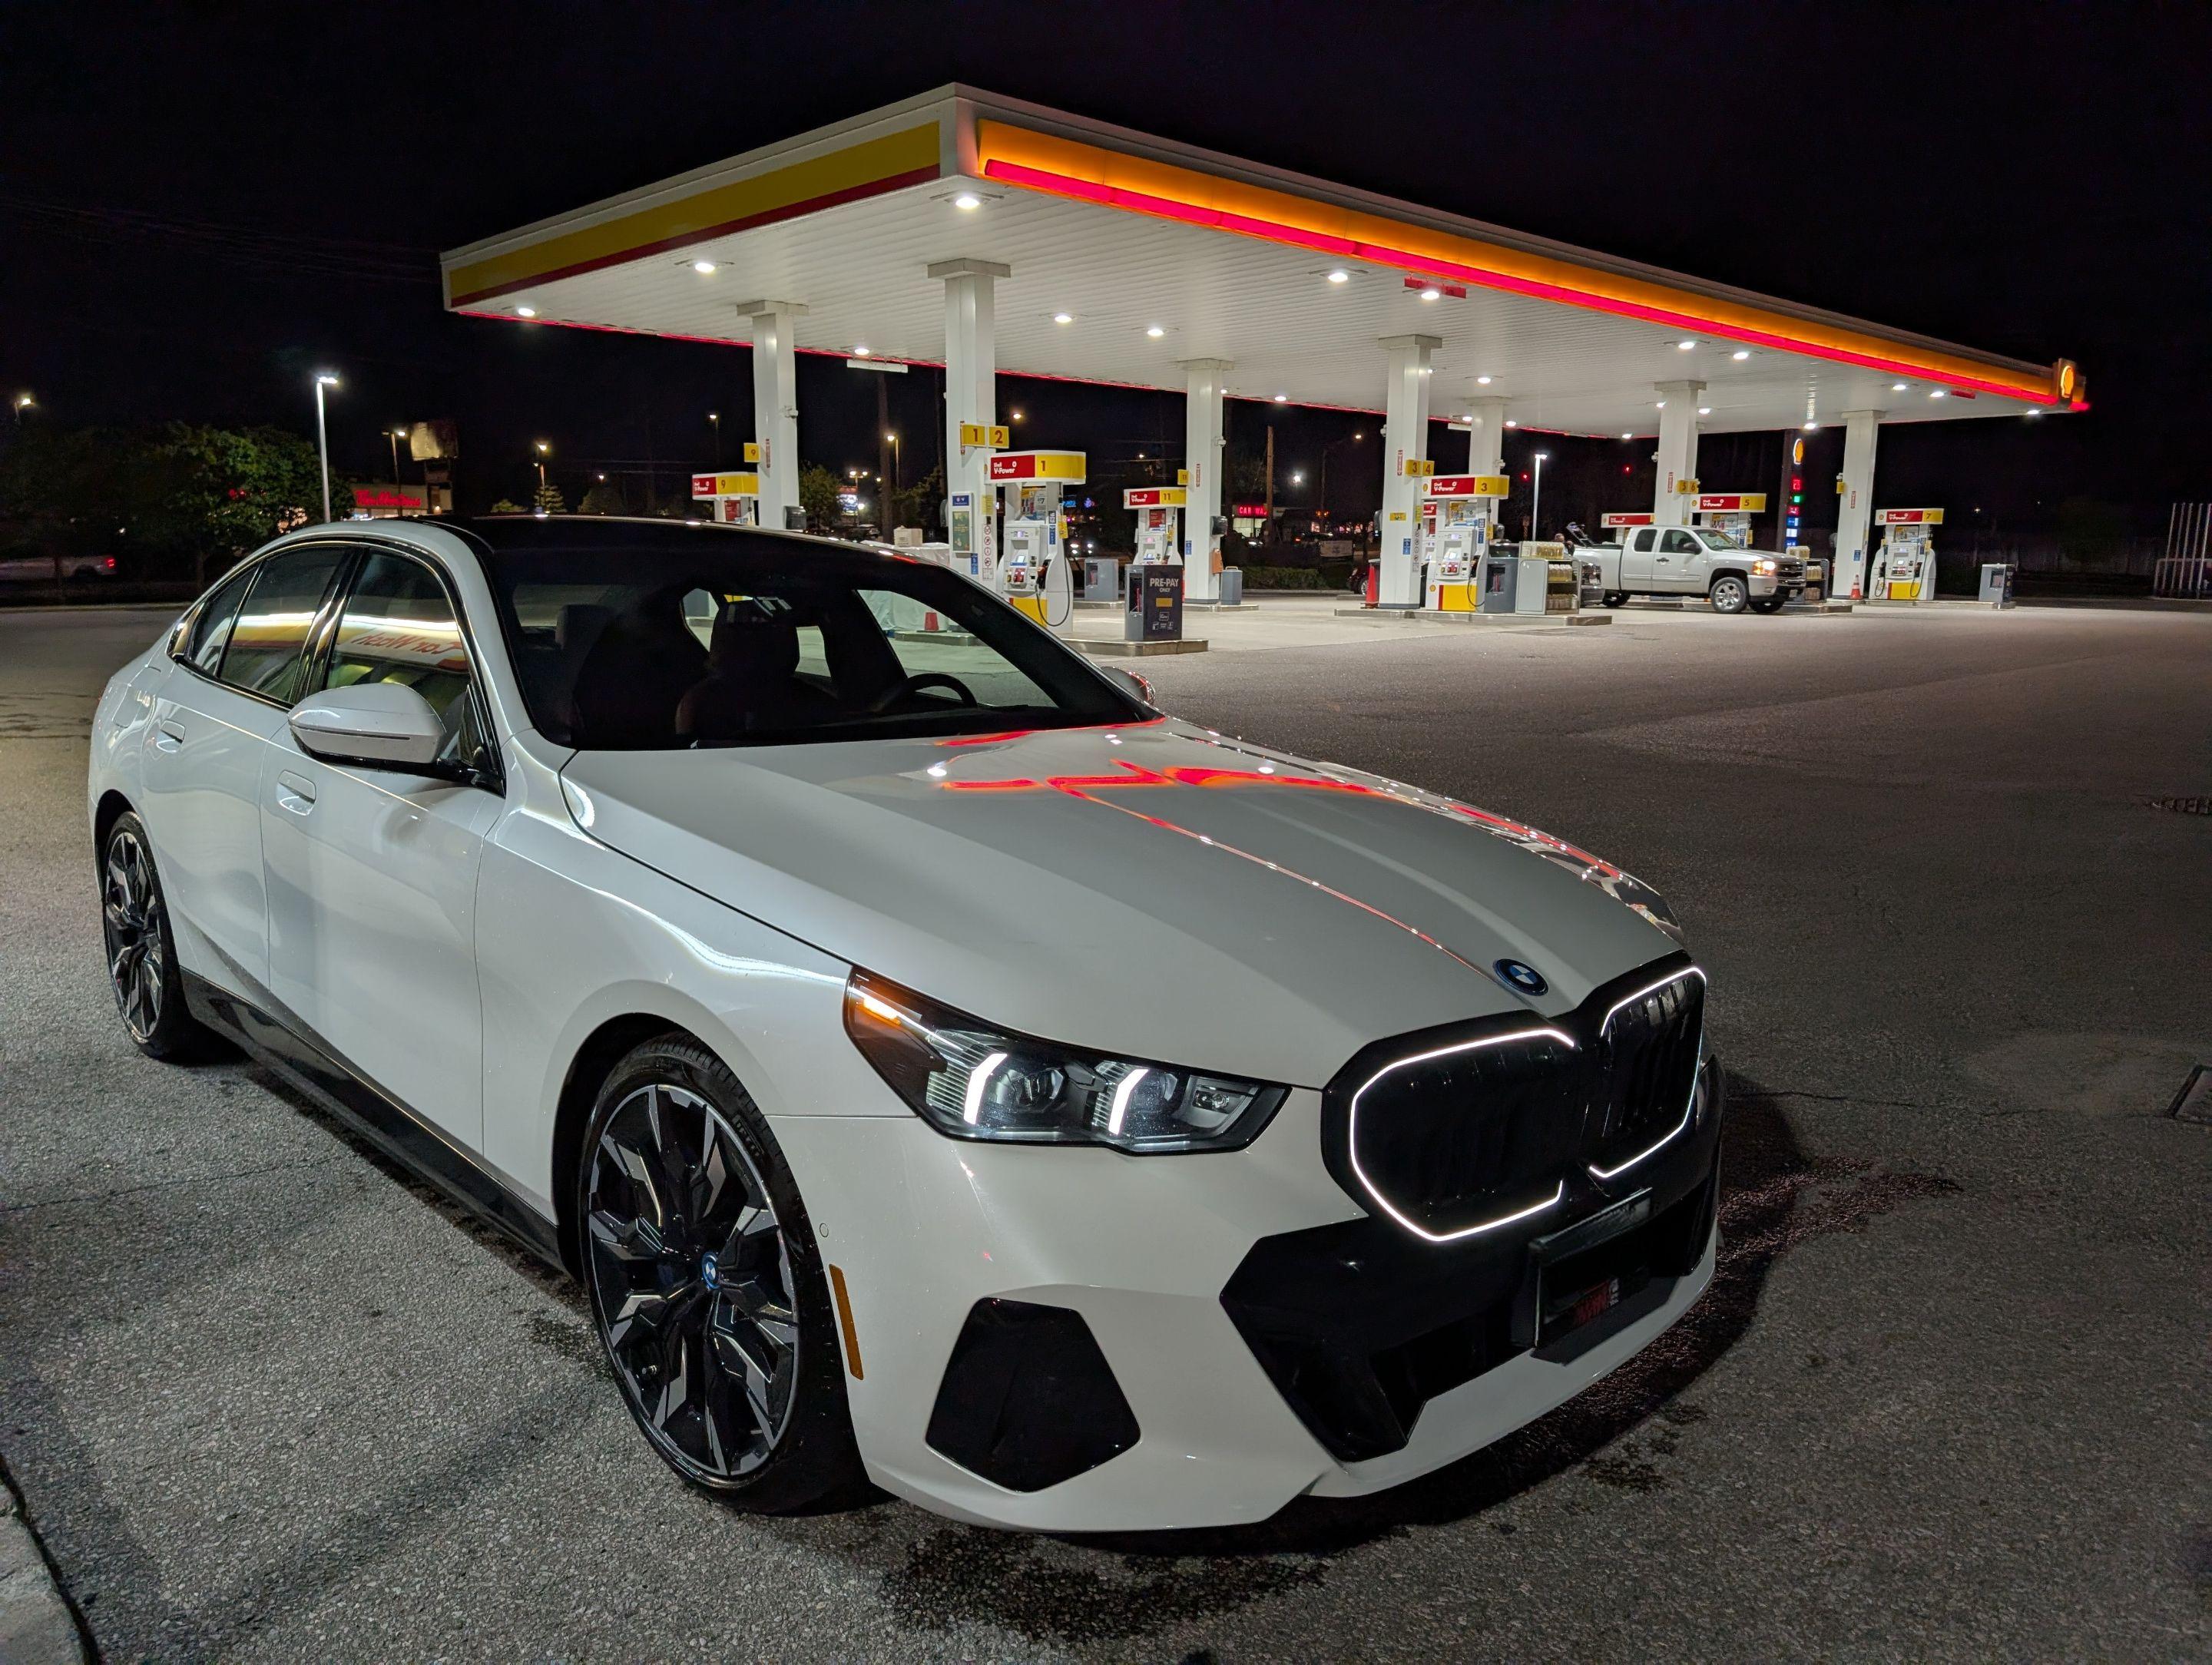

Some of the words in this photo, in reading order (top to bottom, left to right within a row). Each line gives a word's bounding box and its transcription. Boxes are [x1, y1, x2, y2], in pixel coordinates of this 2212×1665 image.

[973, 428, 979, 442] 1
[995, 429, 1004, 444] 2
[1041, 460, 1046, 472] 1
[1412, 462, 1418, 473] 3
[1426, 464, 1431, 474] 4
[720, 479, 726, 489] 9
[1481, 482, 1488, 492] 3
[1163, 492, 1171, 501] 11
[1743, 498, 1750, 507] 5
[1239, 506, 1251, 515] CAR
[1149, 578, 1179, 588] PRE-PAY
